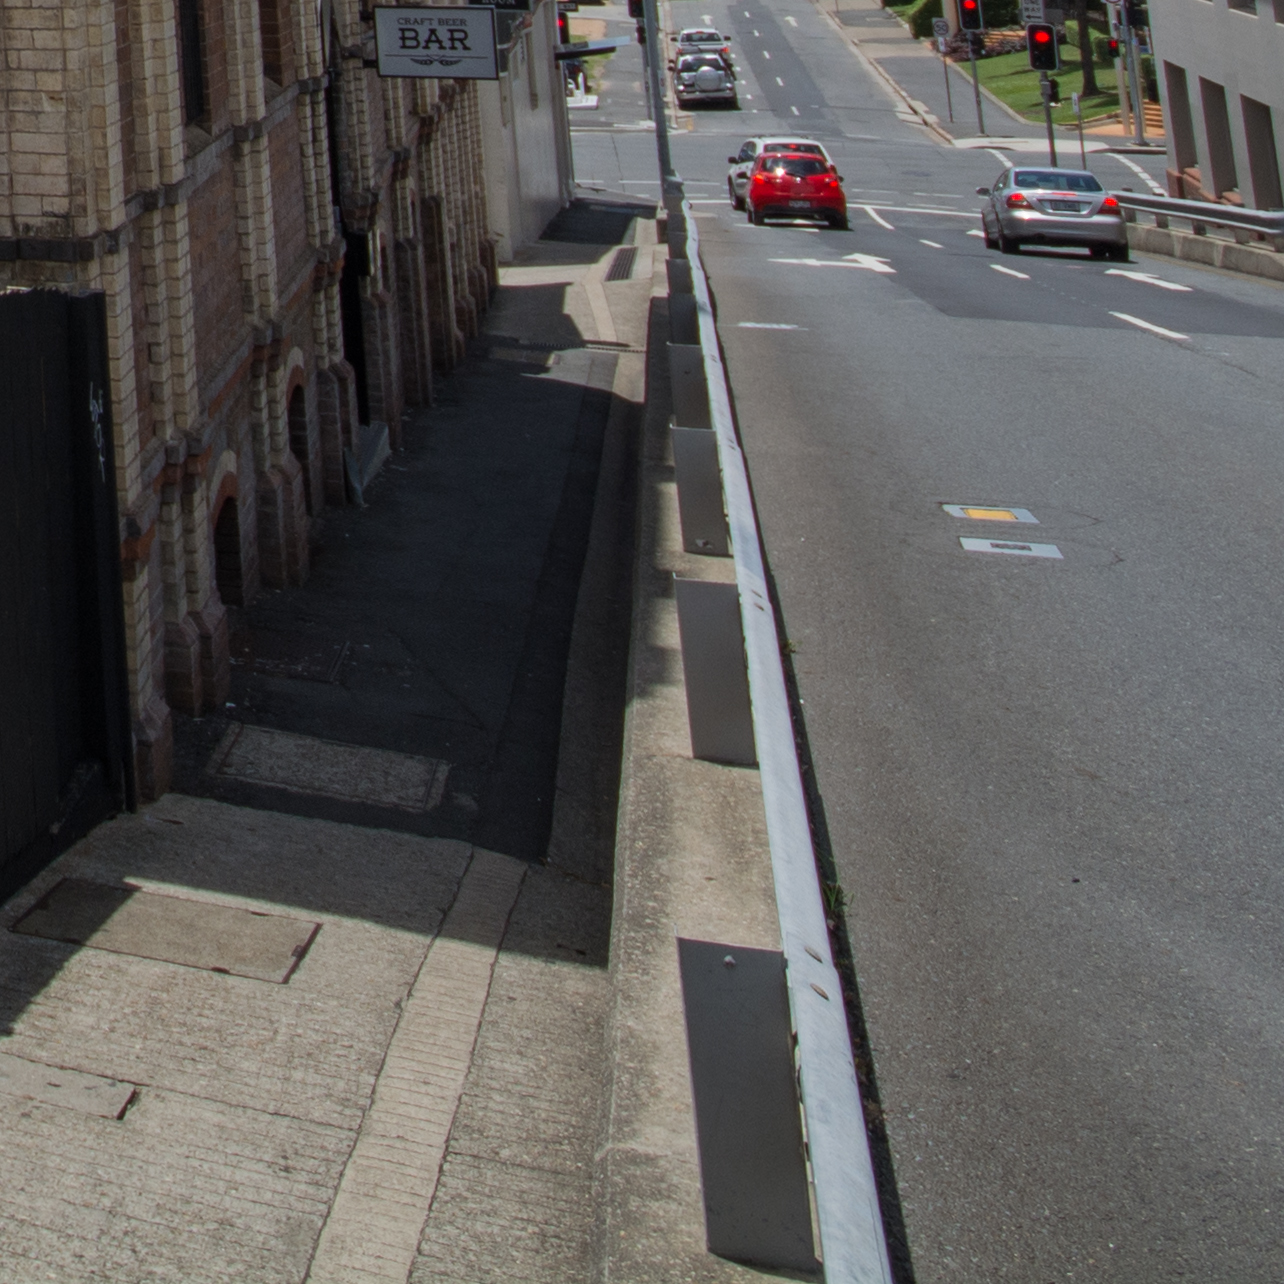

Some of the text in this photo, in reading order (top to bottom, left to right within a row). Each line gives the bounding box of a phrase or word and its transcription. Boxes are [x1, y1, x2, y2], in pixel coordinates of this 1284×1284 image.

[397, 17, 468, 27] CRAFT BEER
[398, 27, 472, 51] BAR
